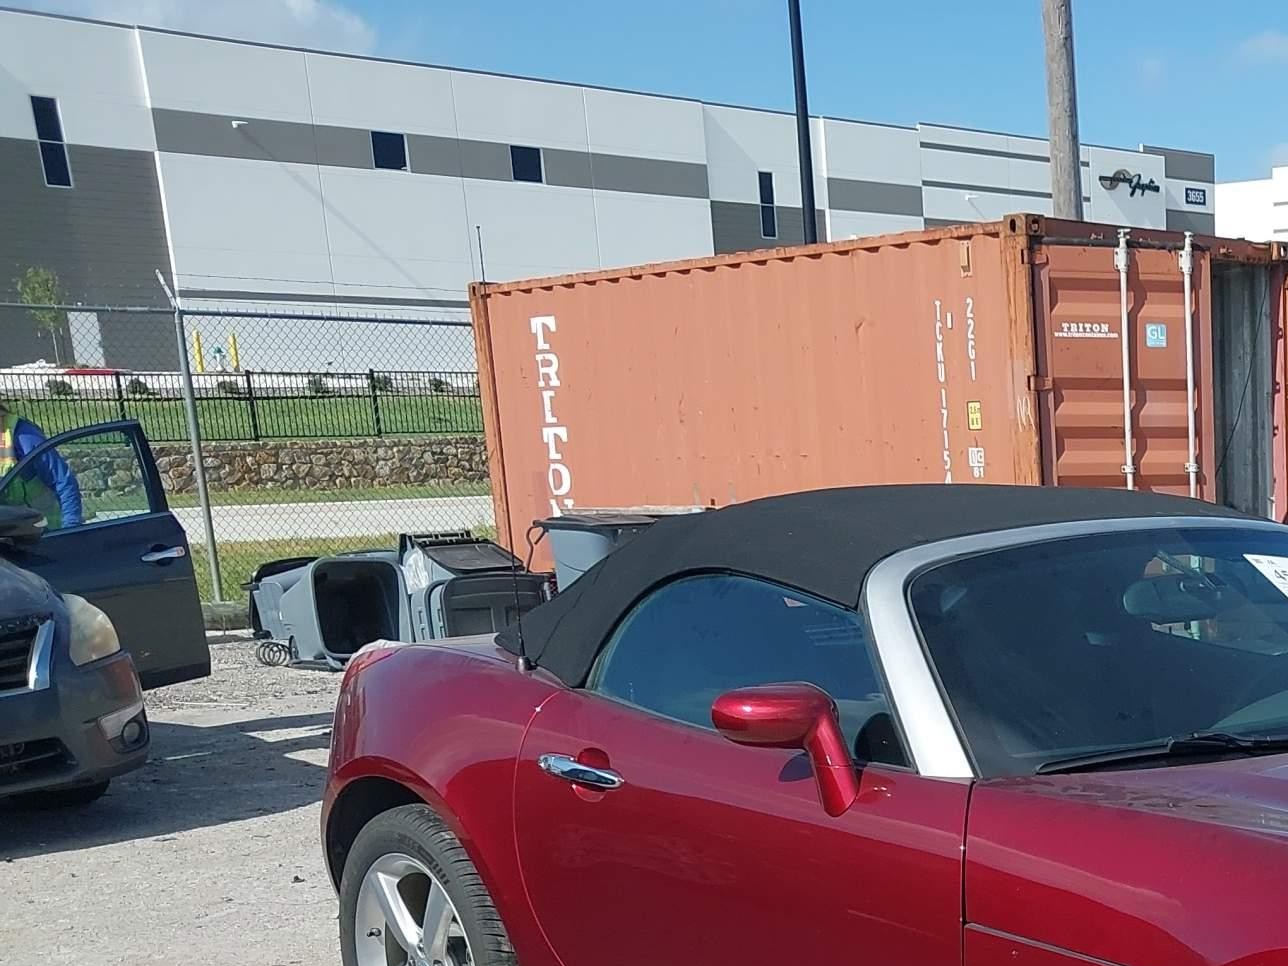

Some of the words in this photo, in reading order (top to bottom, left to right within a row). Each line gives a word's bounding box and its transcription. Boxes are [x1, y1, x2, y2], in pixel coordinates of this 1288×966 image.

[1187, 191, 1204, 203] 3655
[1061, 322, 1110, 332] TRITON
[1148, 326, 1165, 340] GL
[934, 300, 945, 382] TCKU
[966, 297, 976, 381] 22G1
